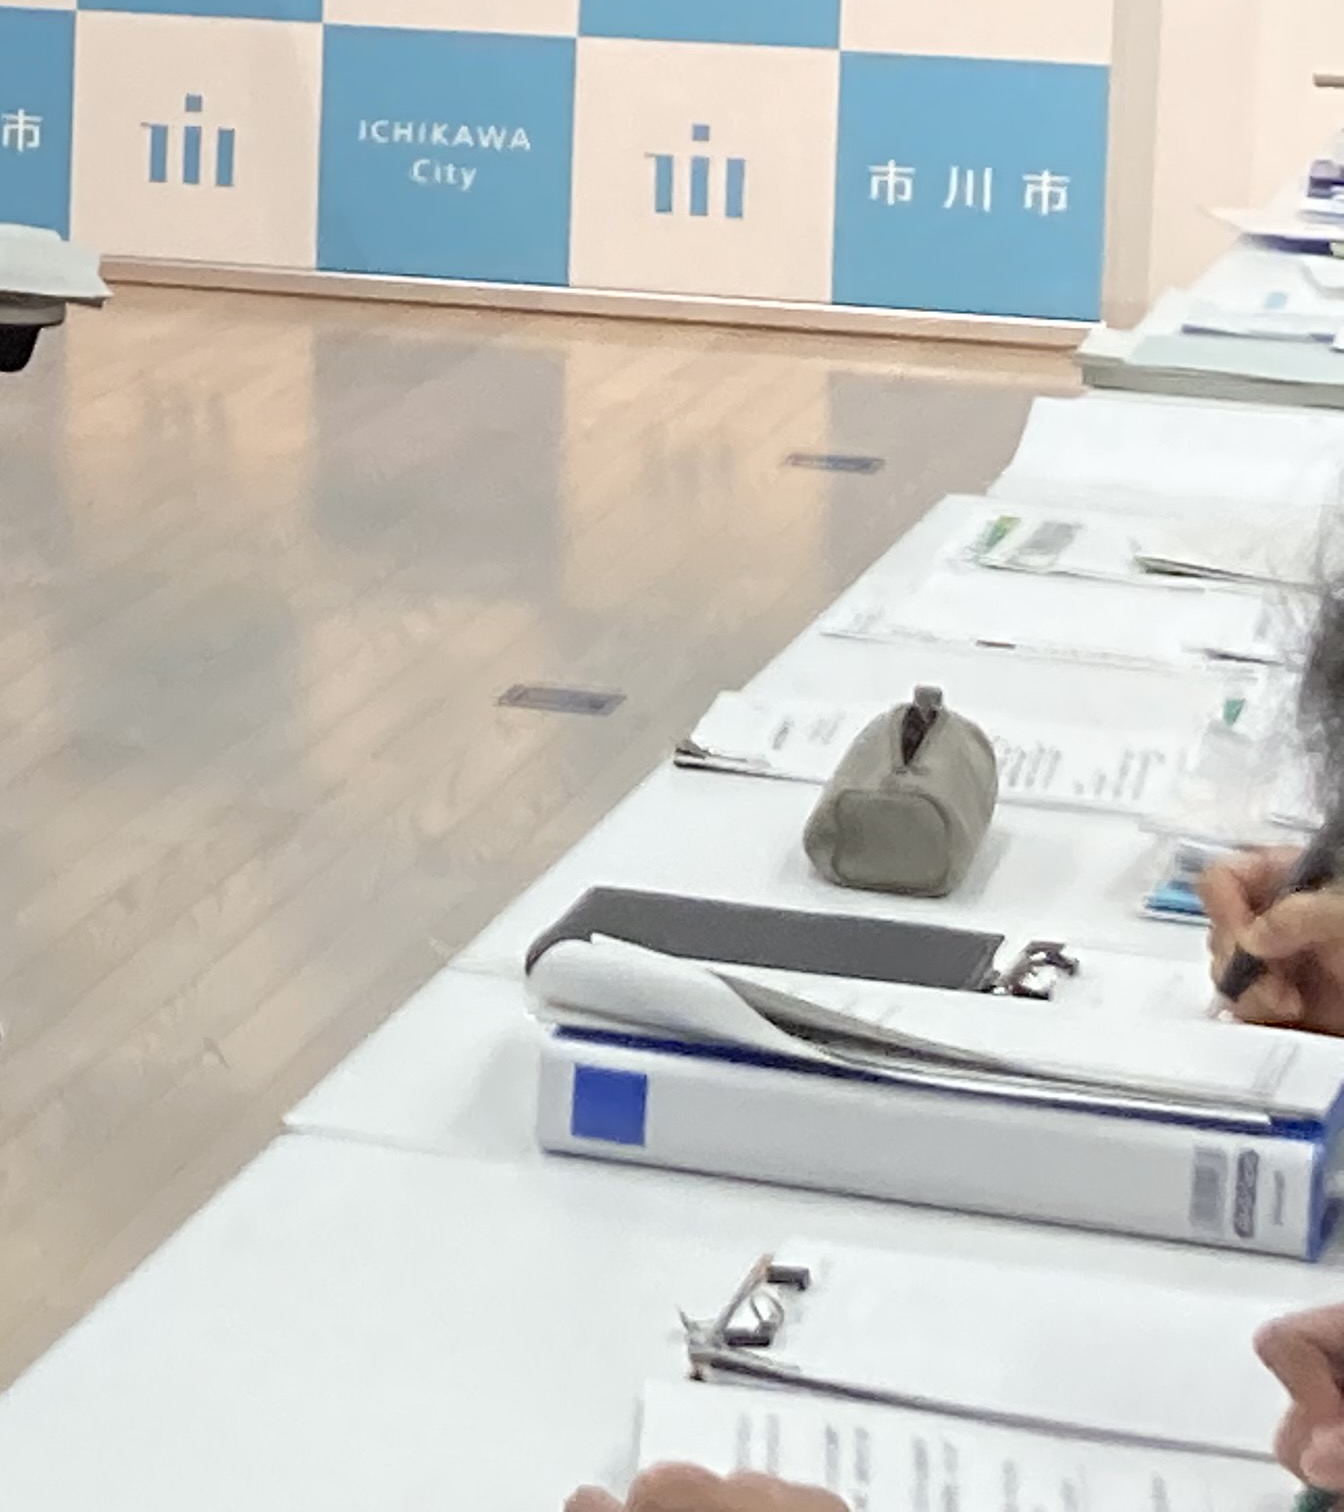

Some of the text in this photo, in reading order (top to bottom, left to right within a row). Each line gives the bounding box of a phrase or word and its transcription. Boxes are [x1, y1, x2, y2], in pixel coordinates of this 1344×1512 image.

[359, 120, 530, 152] ICHIKAWA
[412, 159, 476, 191] City
[870, 160, 1069, 215] 市川市
